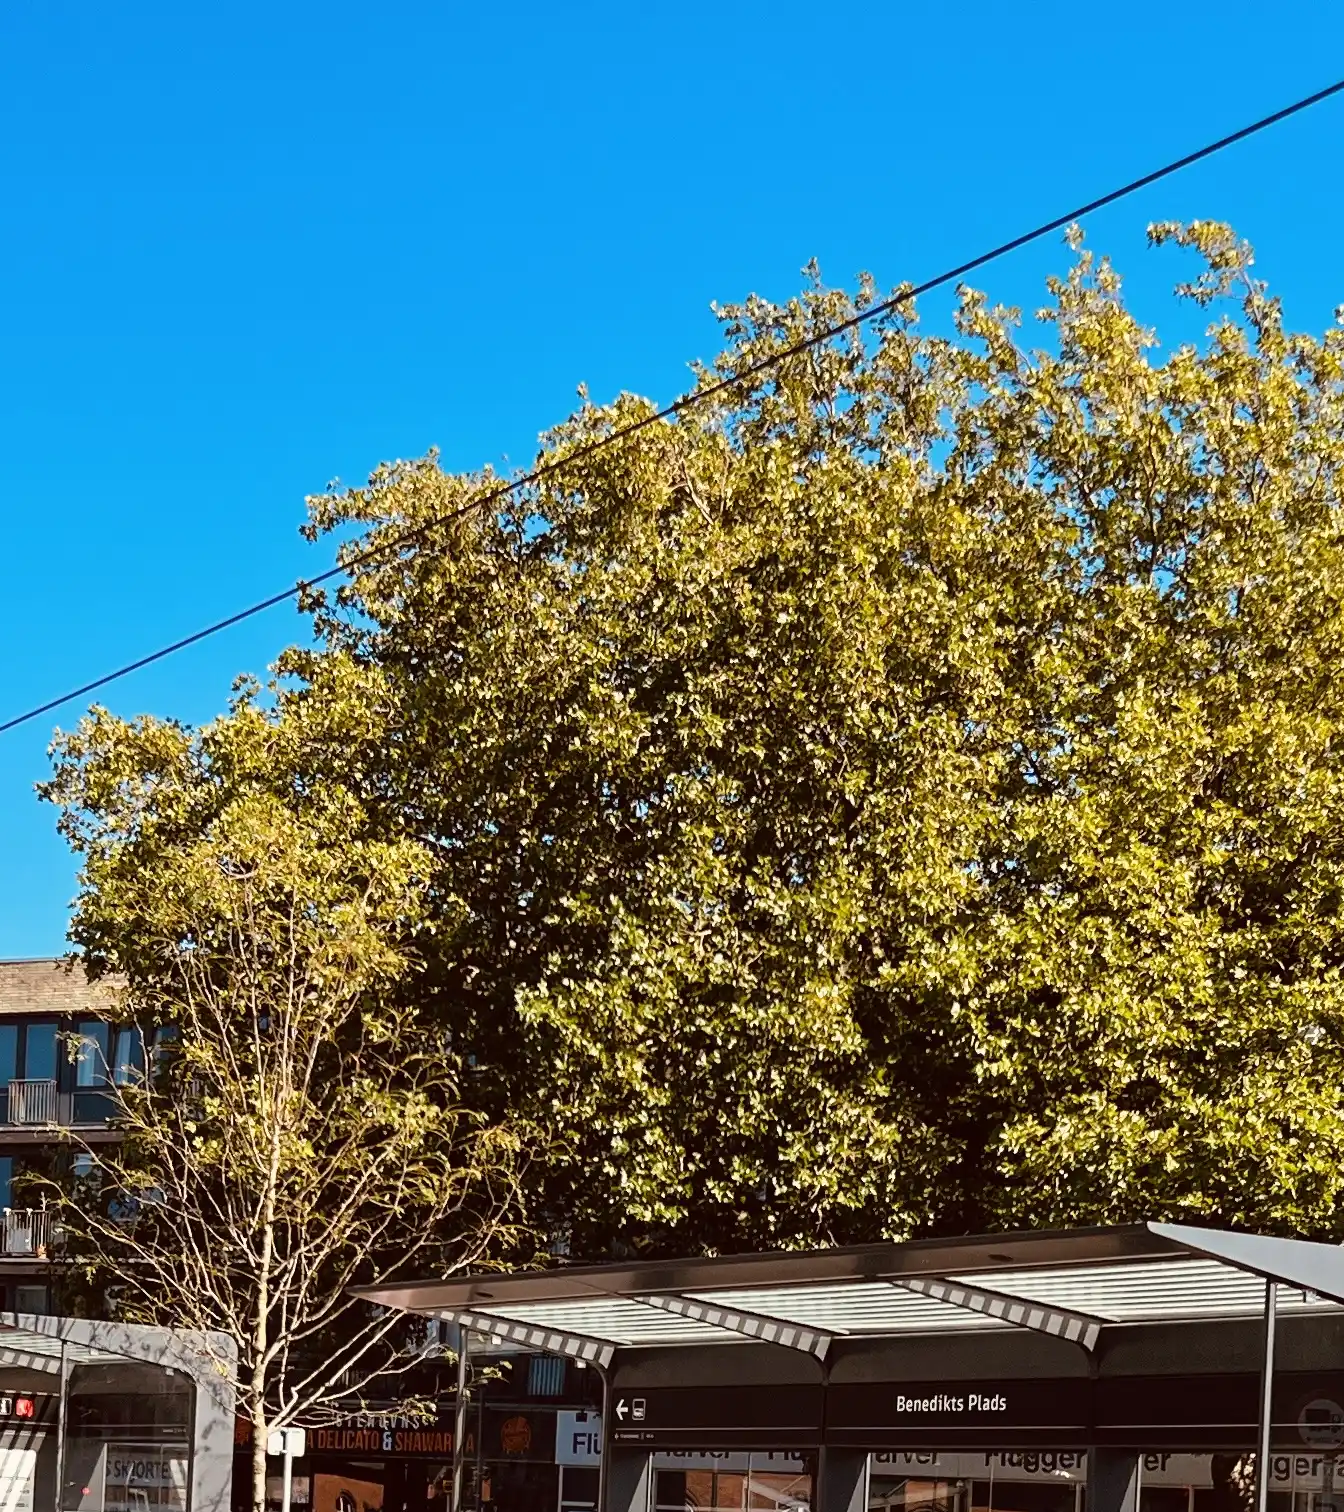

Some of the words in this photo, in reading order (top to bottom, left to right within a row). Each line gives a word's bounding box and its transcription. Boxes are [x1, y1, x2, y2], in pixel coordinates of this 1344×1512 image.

[896, 1394, 964, 1413] Benedikts
[968, 1394, 1007, 1411] Plads
[318, 1429, 379, 1450] DELICATO
[382, 1431, 393, 1451] &
[395, 1431, 475, 1453] SHAWARA
